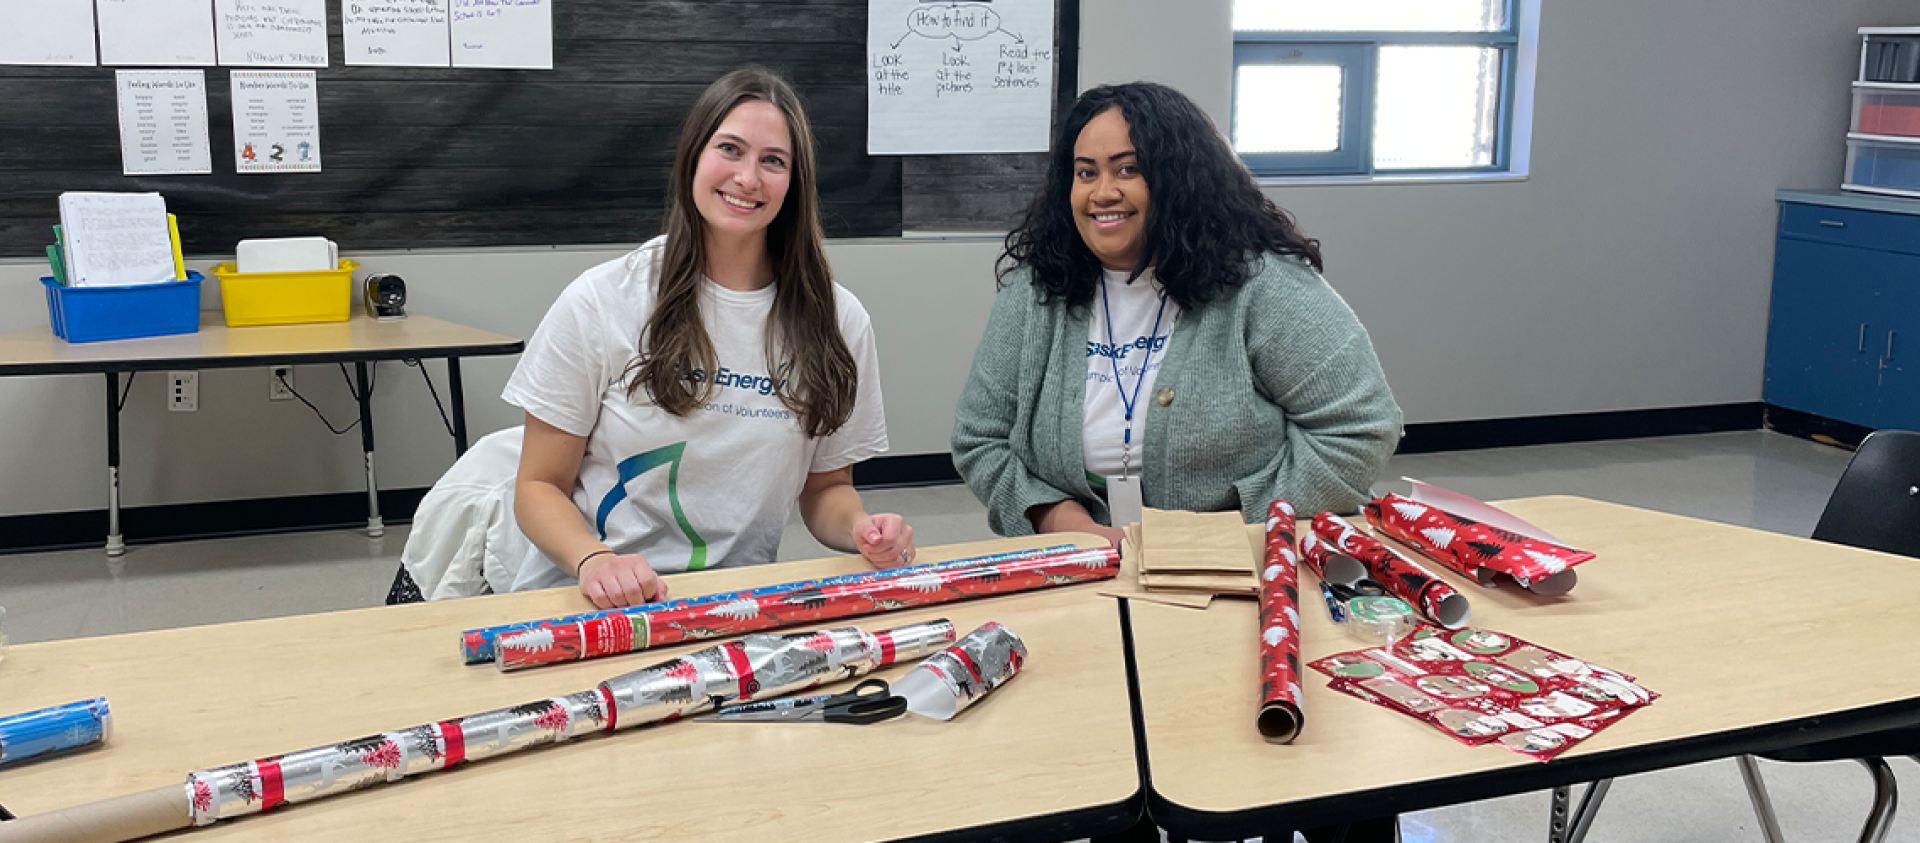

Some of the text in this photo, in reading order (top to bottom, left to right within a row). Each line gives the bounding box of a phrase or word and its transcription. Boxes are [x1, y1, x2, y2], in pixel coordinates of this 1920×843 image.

[917, 10, 990, 28] How to find it
[942, 52, 970, 66] Look
[1000, 44, 1051, 61] Read the
[873, 53, 902, 68] Look
[875, 69, 909, 80] at the
[936, 69, 971, 80] at the
[878, 82, 904, 95] title
[936, 82, 973, 98] pictures
[242, 144, 257, 160] 4
[269, 144, 285, 161] 2
[722, 403, 734, 414] of
[736, 404, 790, 420] Volunteers
